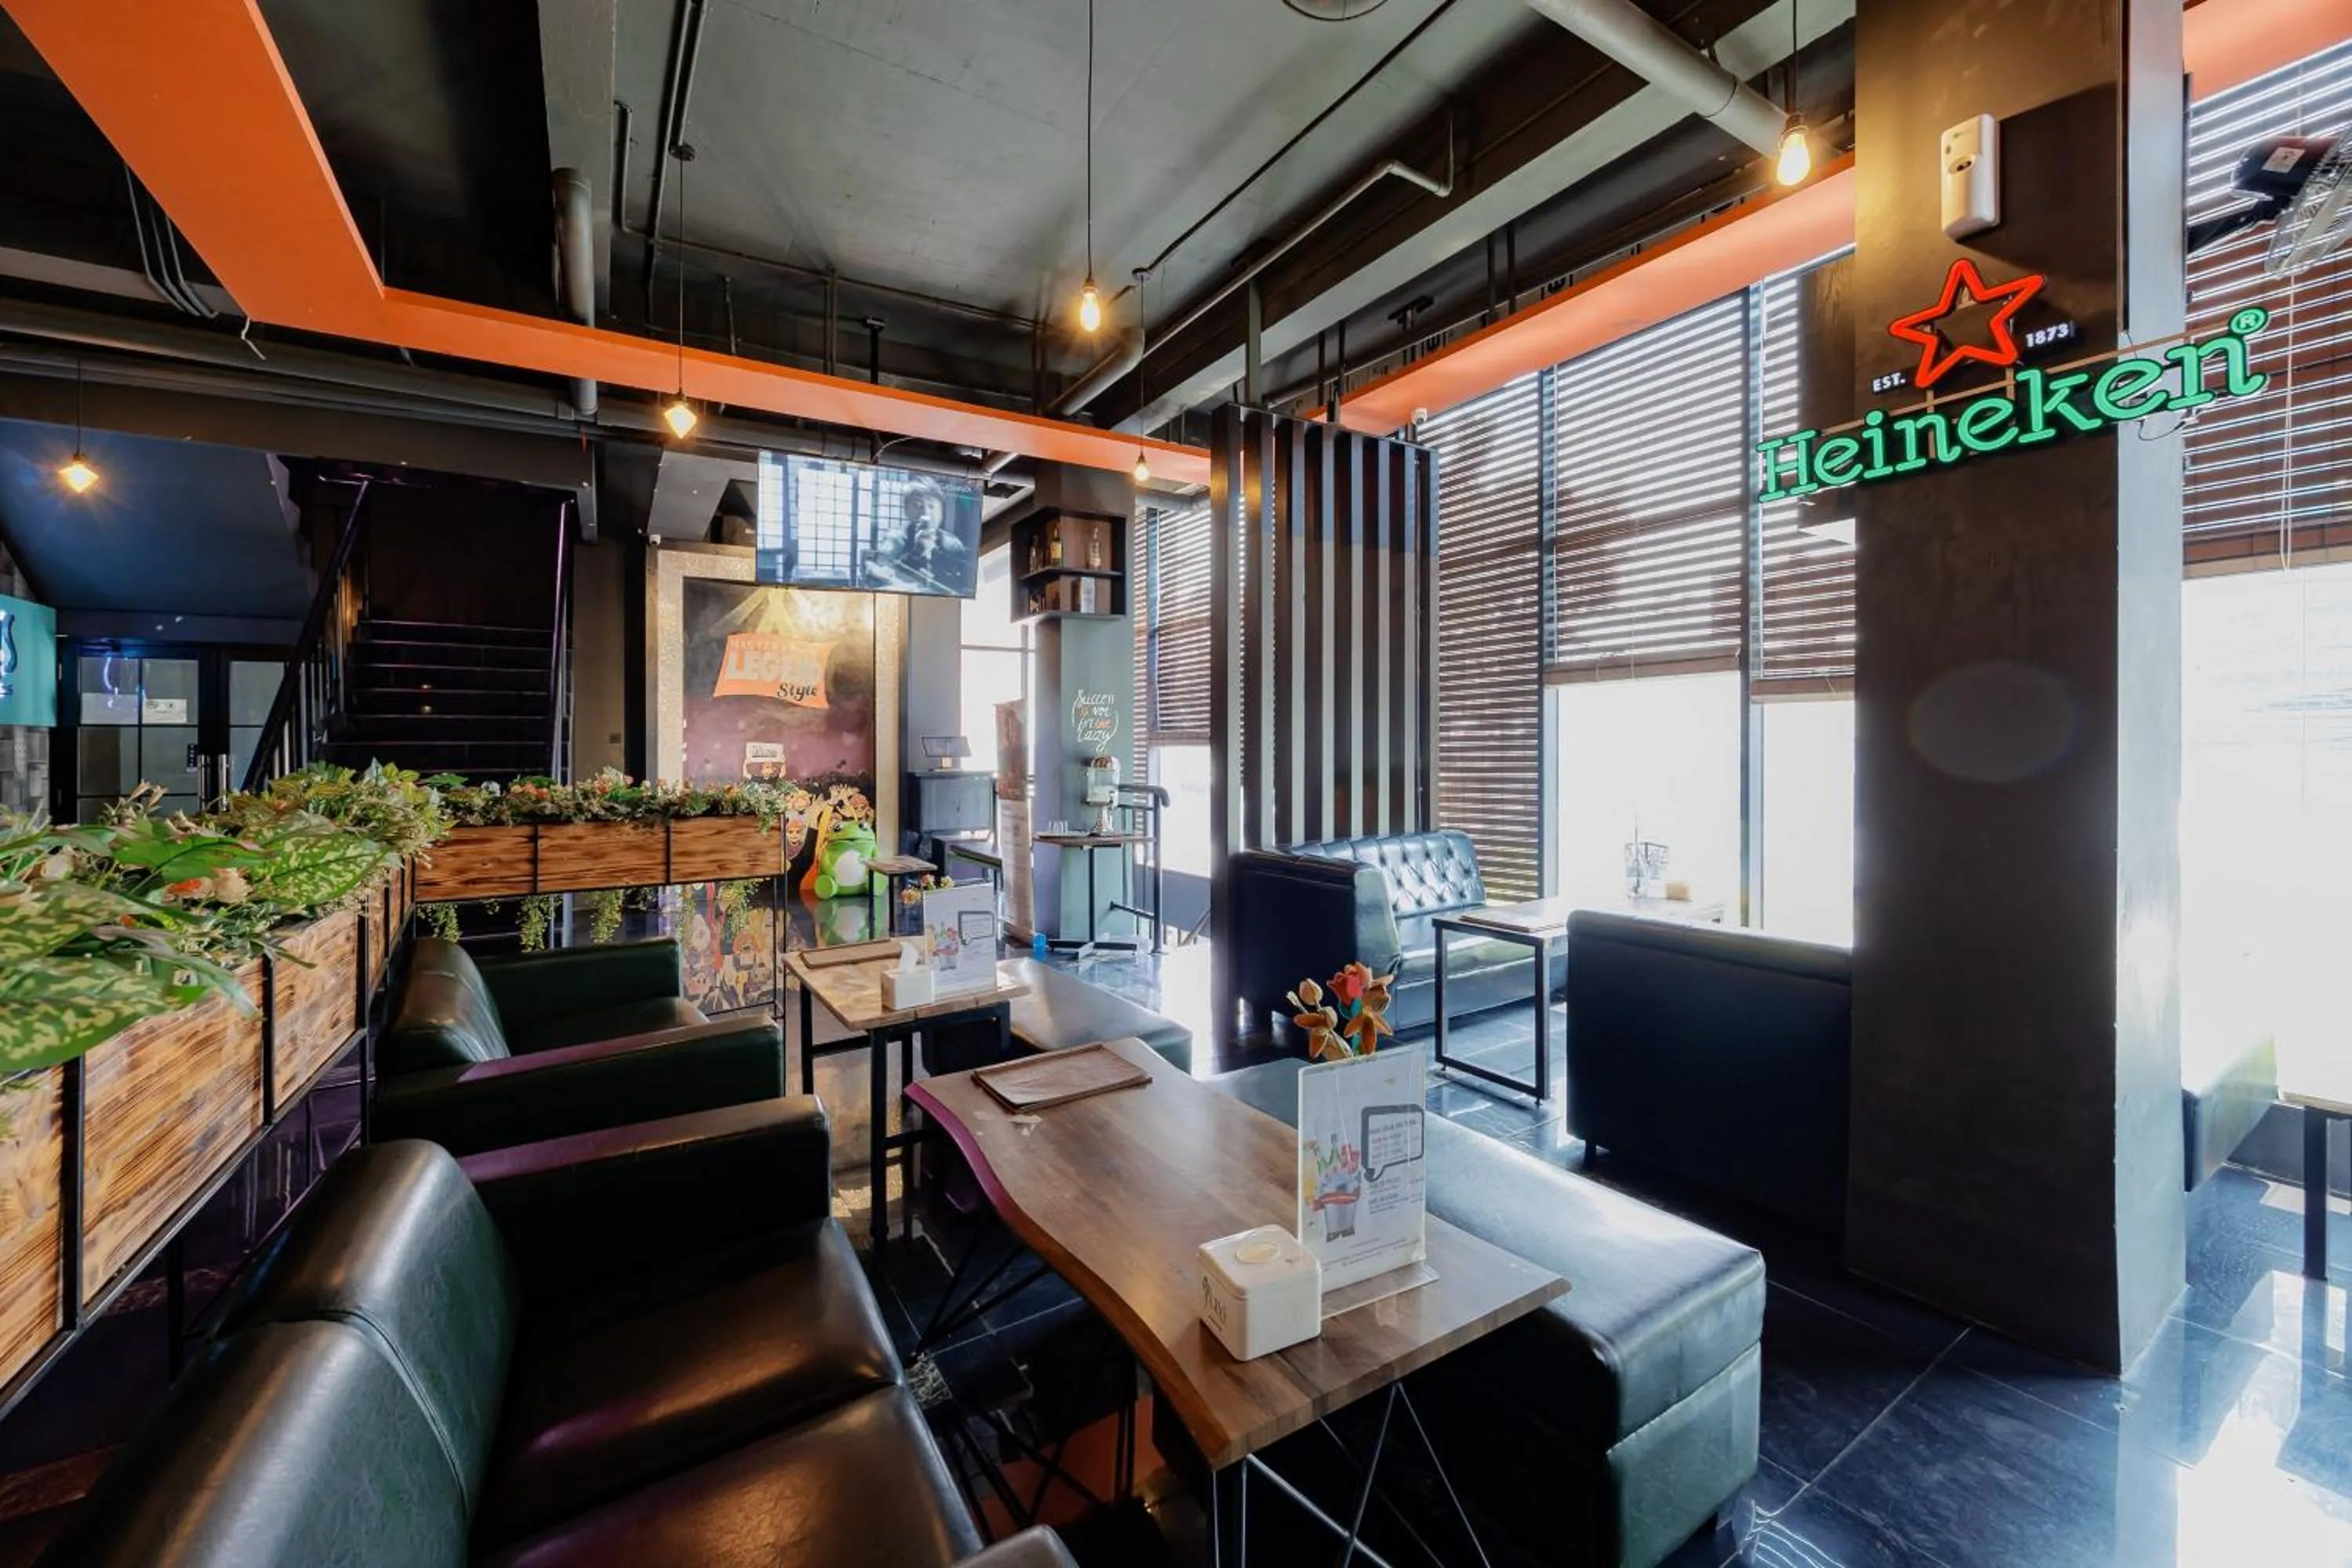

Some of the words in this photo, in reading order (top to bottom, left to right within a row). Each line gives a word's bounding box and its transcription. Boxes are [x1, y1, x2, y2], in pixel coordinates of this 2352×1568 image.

[1872, 372, 1907, 392] EST.
[2025, 322, 2069, 347] 1873
[1756, 340, 2270, 503] Heineken
[777, 682, 817, 701] Style
